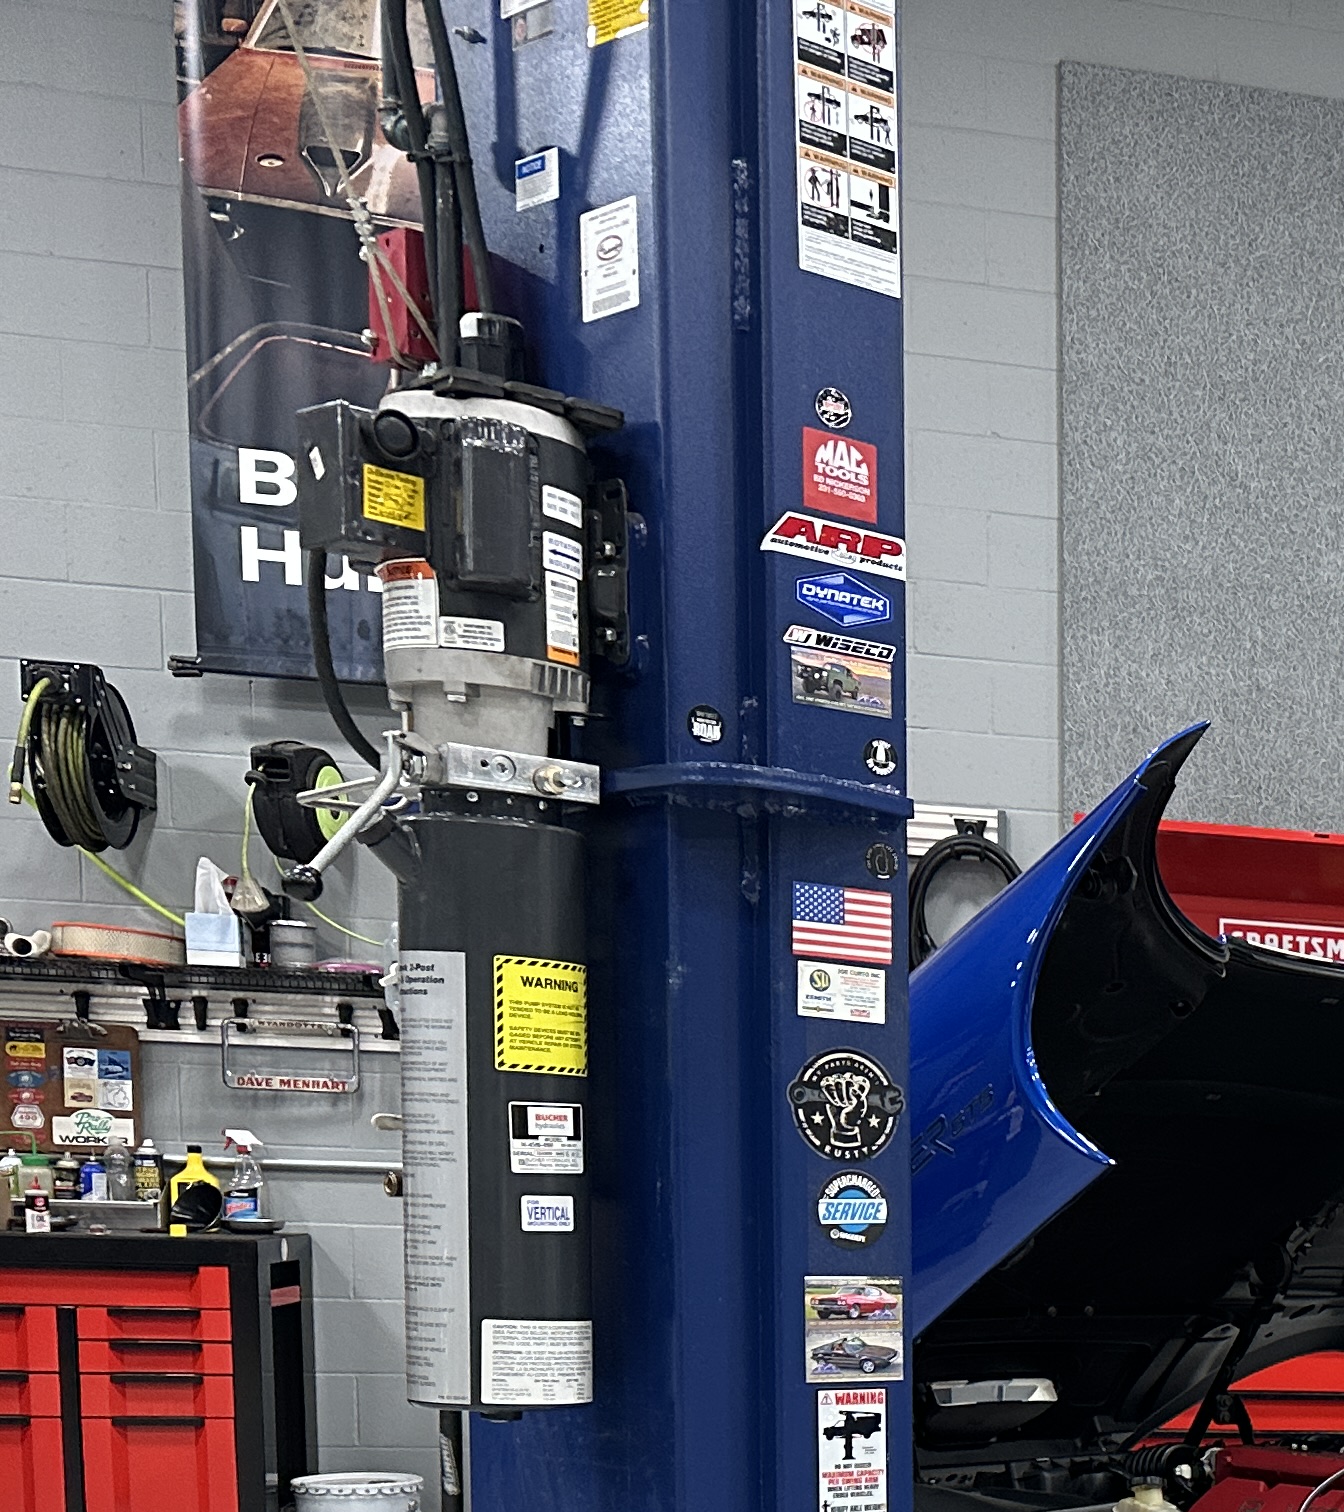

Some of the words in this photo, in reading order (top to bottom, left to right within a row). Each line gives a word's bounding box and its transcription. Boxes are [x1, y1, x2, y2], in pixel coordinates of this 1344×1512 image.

[815, 440, 869, 476] MAC
[815, 462, 869, 485] TOOLS
[772, 516, 903, 558] ARP
[770, 537, 830, 555] automotive
[859, 557, 903, 571] products
[802, 583, 884, 610] DYNATEK
[520, 975, 578, 993] WARNING
[257, 1020, 323, 1029] WYANDOTTE
[824, 1060, 851, 1070] PARTS
[236, 1076, 274, 1087] DAVE
[279, 1078, 348, 1091] MENHART
[535, 1114, 568, 1122] BUCHER
[59, 1135, 128, 1144] WORKR
[824, 1145, 869, 1159] RUSTY
[824, 1174, 881, 1198] SUPERCHARGED
[527, 1207, 570, 1220] VERTICAL
[822, 1201, 882, 1221] SERVICE
[835, 1392, 884, 1405] WARNING
[857, 1469, 884, 1477] CAPACITY
